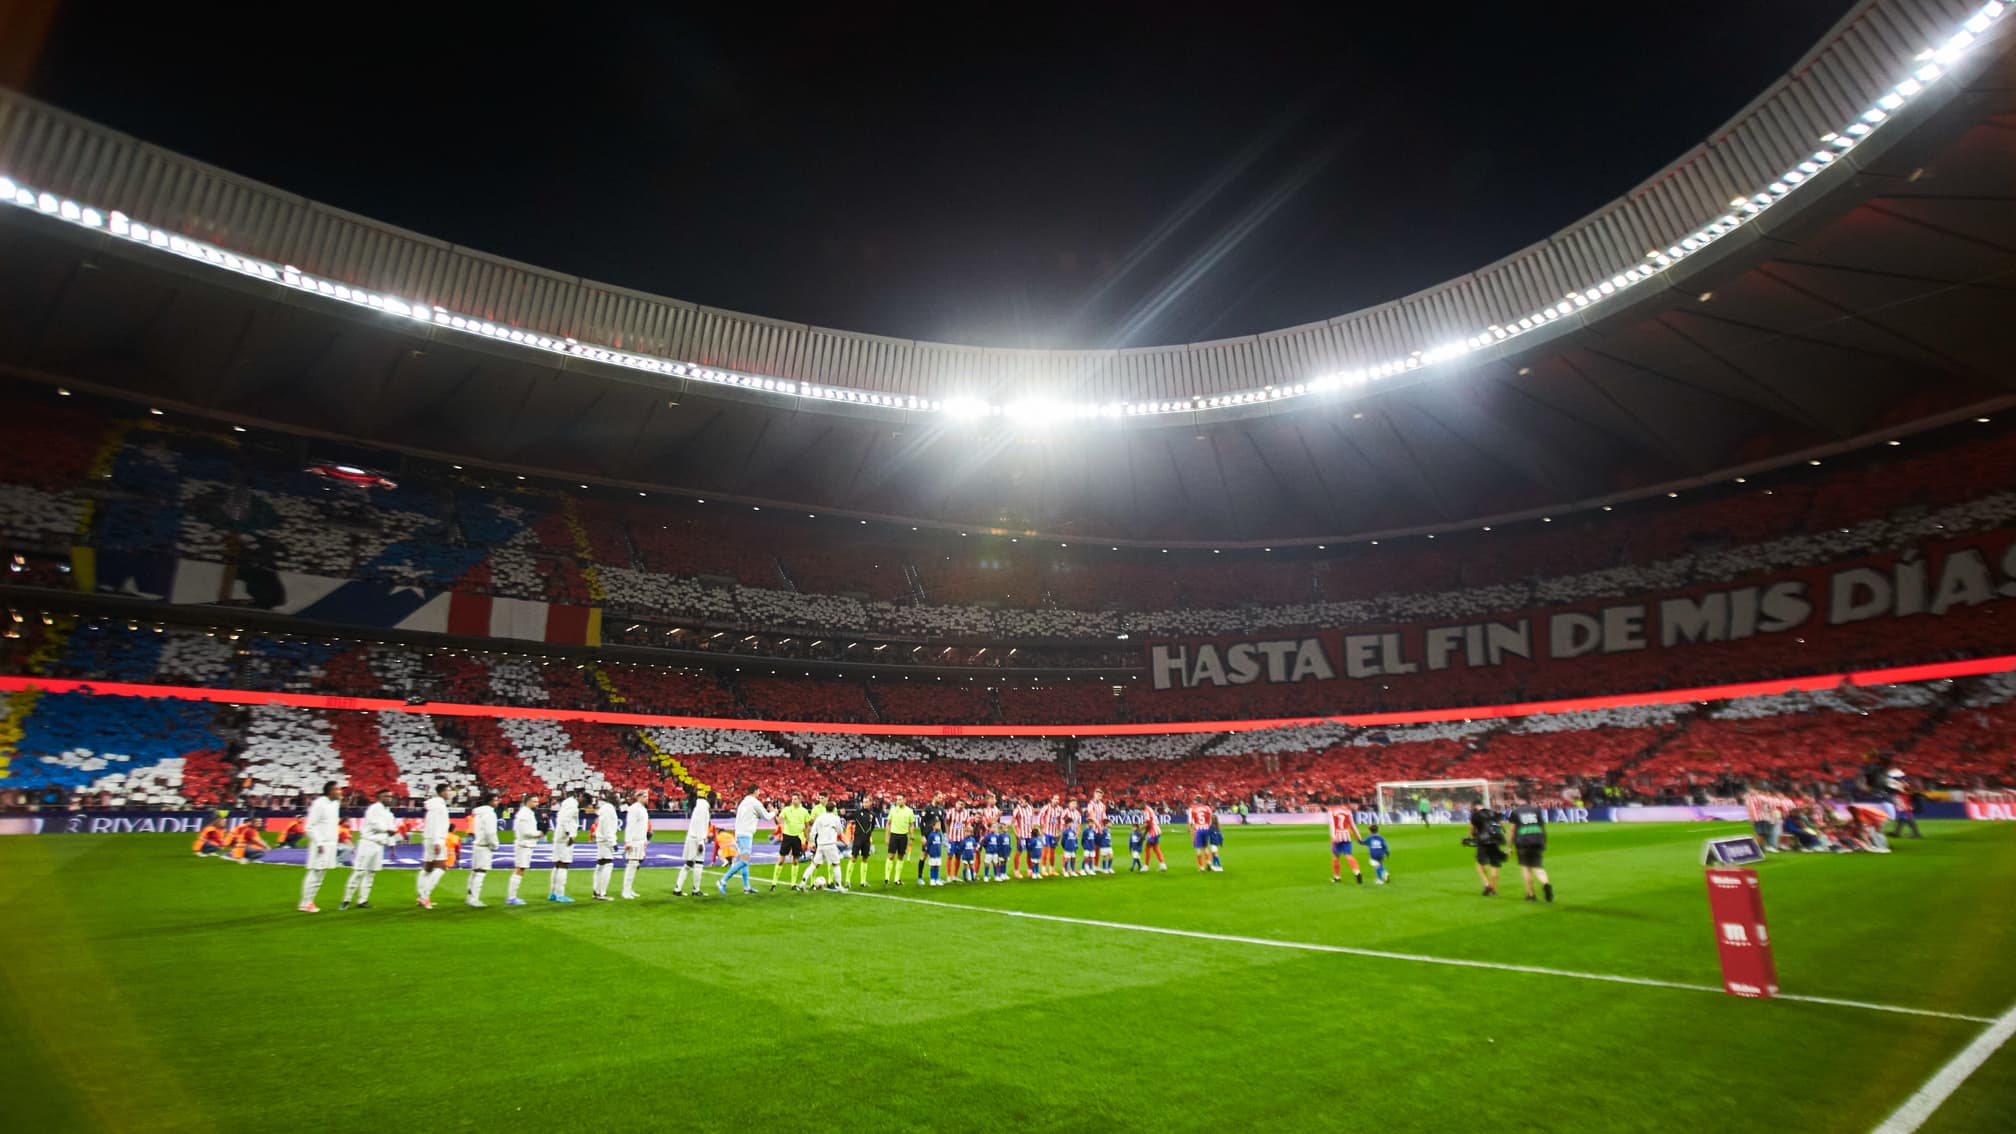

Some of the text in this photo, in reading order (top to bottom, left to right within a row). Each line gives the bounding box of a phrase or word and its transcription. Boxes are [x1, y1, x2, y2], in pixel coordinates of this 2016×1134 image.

[1152, 638, 1335, 690] HASTA
[1345, 633, 1418, 679] EL
[1427, 618, 1531, 670] FIN
[1551, 605, 1647, 658] DE
[1661, 582, 1812, 648] MIS
[1337, 814, 1346, 830] 7
[1556, 808, 1590, 822] AIR
[92, 818, 202, 833] RIYADH
